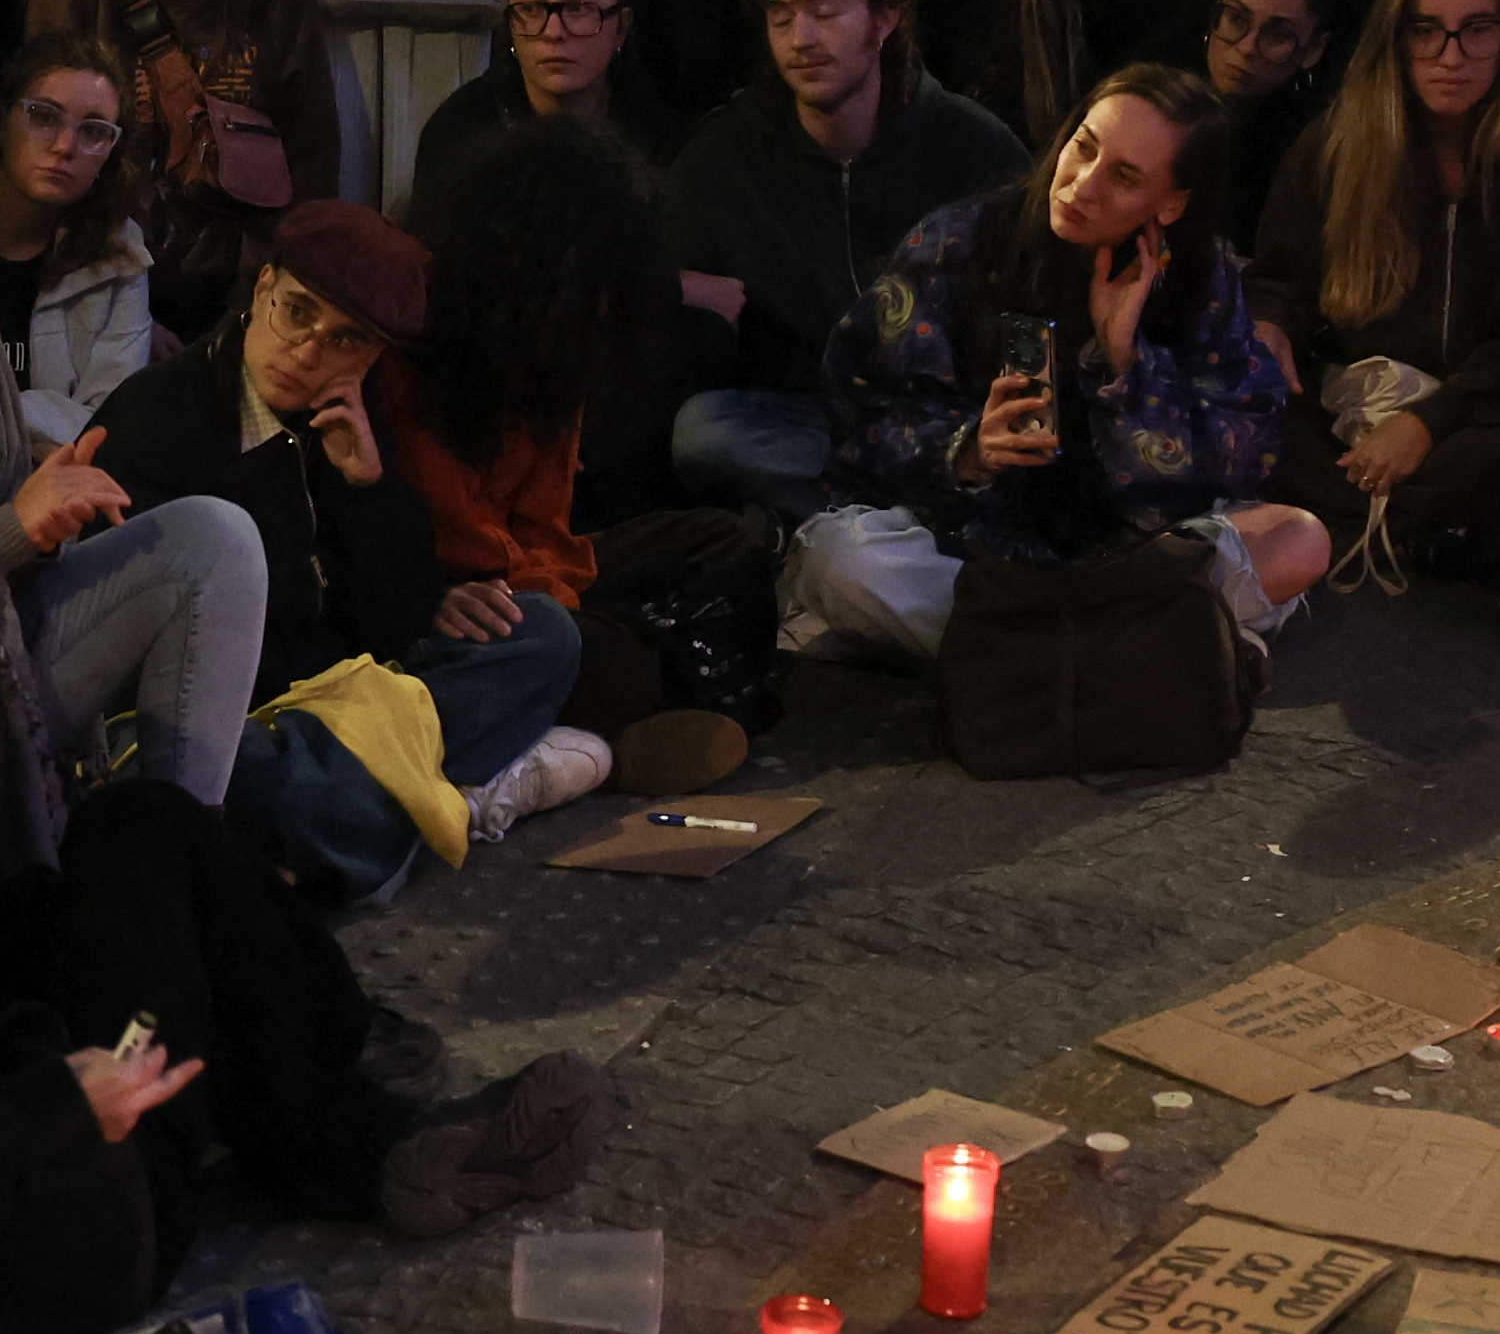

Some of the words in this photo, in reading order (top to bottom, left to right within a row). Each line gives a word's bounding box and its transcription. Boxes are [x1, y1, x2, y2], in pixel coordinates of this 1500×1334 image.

[1215, 1251, 1293, 1294] QUE
[1272, 1247, 1374, 1320] LUCHAD
[1168, 1301, 1239, 1334] ES
